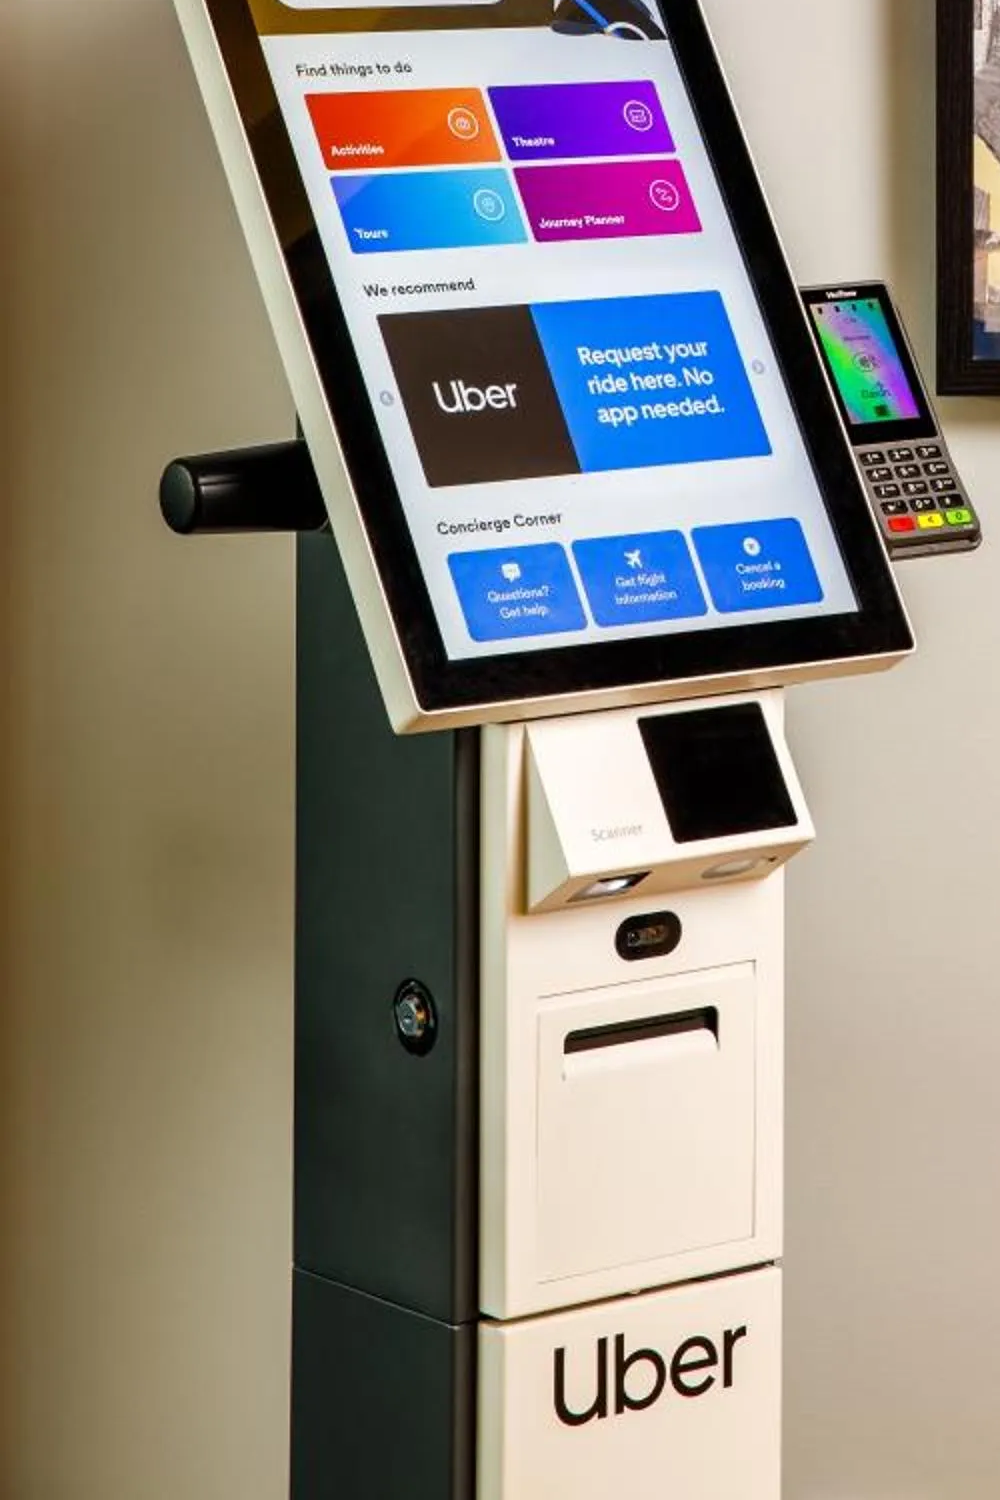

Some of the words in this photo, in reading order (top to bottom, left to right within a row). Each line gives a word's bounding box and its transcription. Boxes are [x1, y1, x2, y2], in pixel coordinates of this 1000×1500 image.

[296, 63, 327, 77] Find
[329, 62, 373, 77] things
[375, 62, 391, 74] to
[394, 60, 412, 73] do
[331, 144, 384, 157] Activities
[511, 136, 556, 148] Theatre
[539, 218, 583, 229] Journey
[583, 214, 625, 226] Planner
[353, 227, 389, 240] Tours
[363, 284, 388, 297] We
[390, 278, 475, 296] recommend
[576, 342, 663, 368] Request
[664, 341, 708, 364] your
[587, 373, 628, 395] ride
[629, 372, 682, 391] here.
[681, 366, 713, 387] No
[432, 379, 517, 413] Uber
[597, 404, 638, 428] app
[640, 394, 725, 419] needed.
[437, 518, 511, 535] Concierge
[513, 513, 561, 527] Corner
[735, 560, 772, 575] Cancel
[773, 561, 782, 571] a
[615, 576, 636, 588] Get
[741, 578, 785, 591] booking
[487, 585, 549, 604] Questions?
[615, 590, 677, 605] information
[499, 606, 520, 619] Get
[590, 824, 643, 843] Scanner
[553, 1324, 747, 1427] Uber
